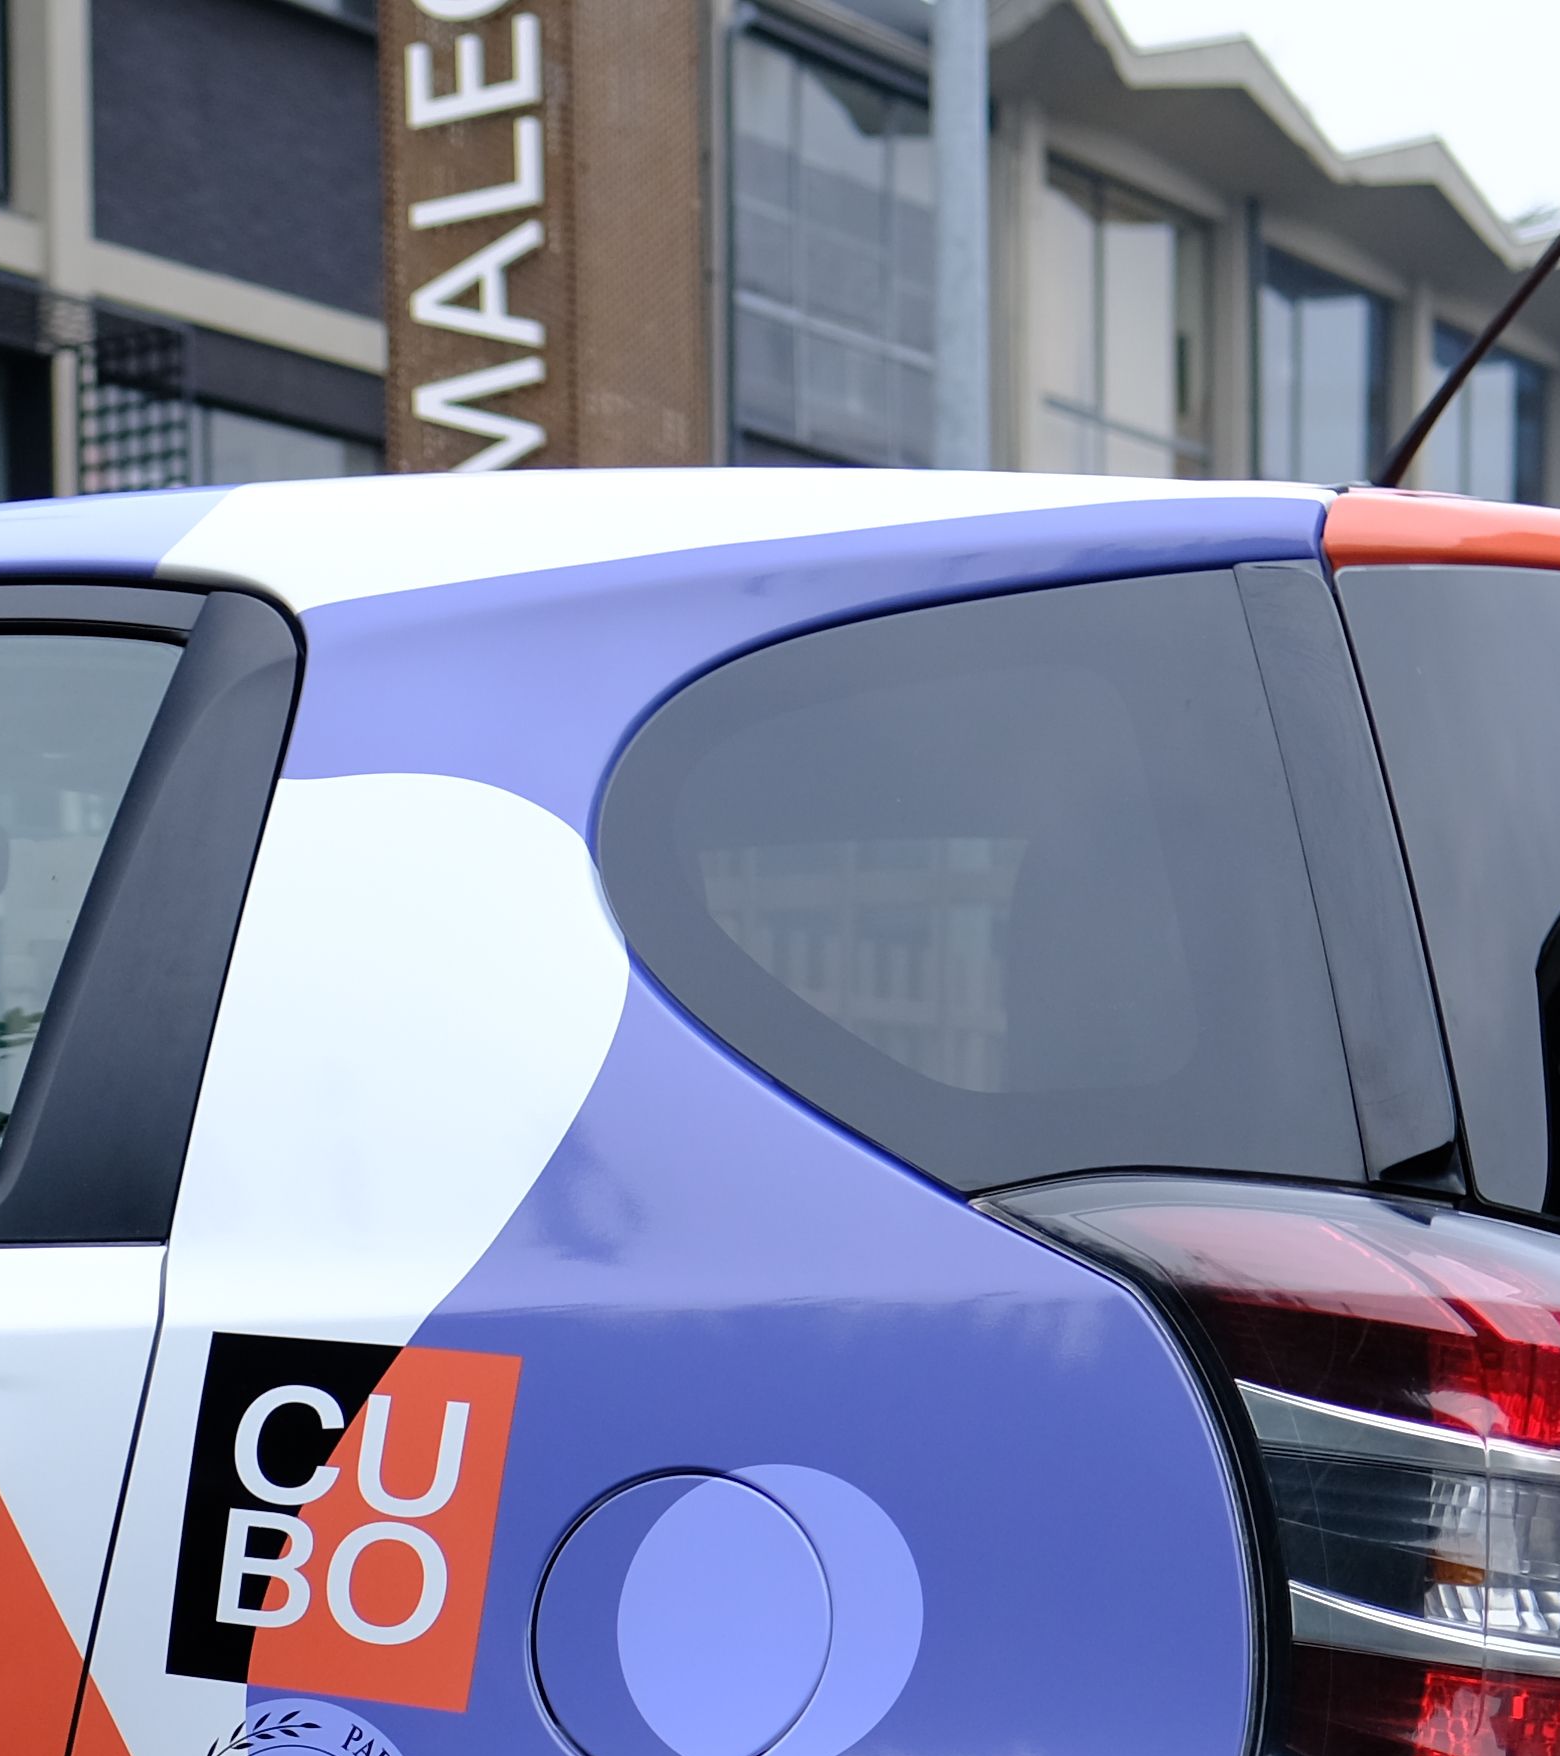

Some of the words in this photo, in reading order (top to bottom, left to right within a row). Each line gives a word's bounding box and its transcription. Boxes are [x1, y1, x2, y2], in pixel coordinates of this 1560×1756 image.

[404, 0, 547, 472] MALE
[233, 1384, 471, 1518] CU
[215, 1507, 448, 1646] BO
